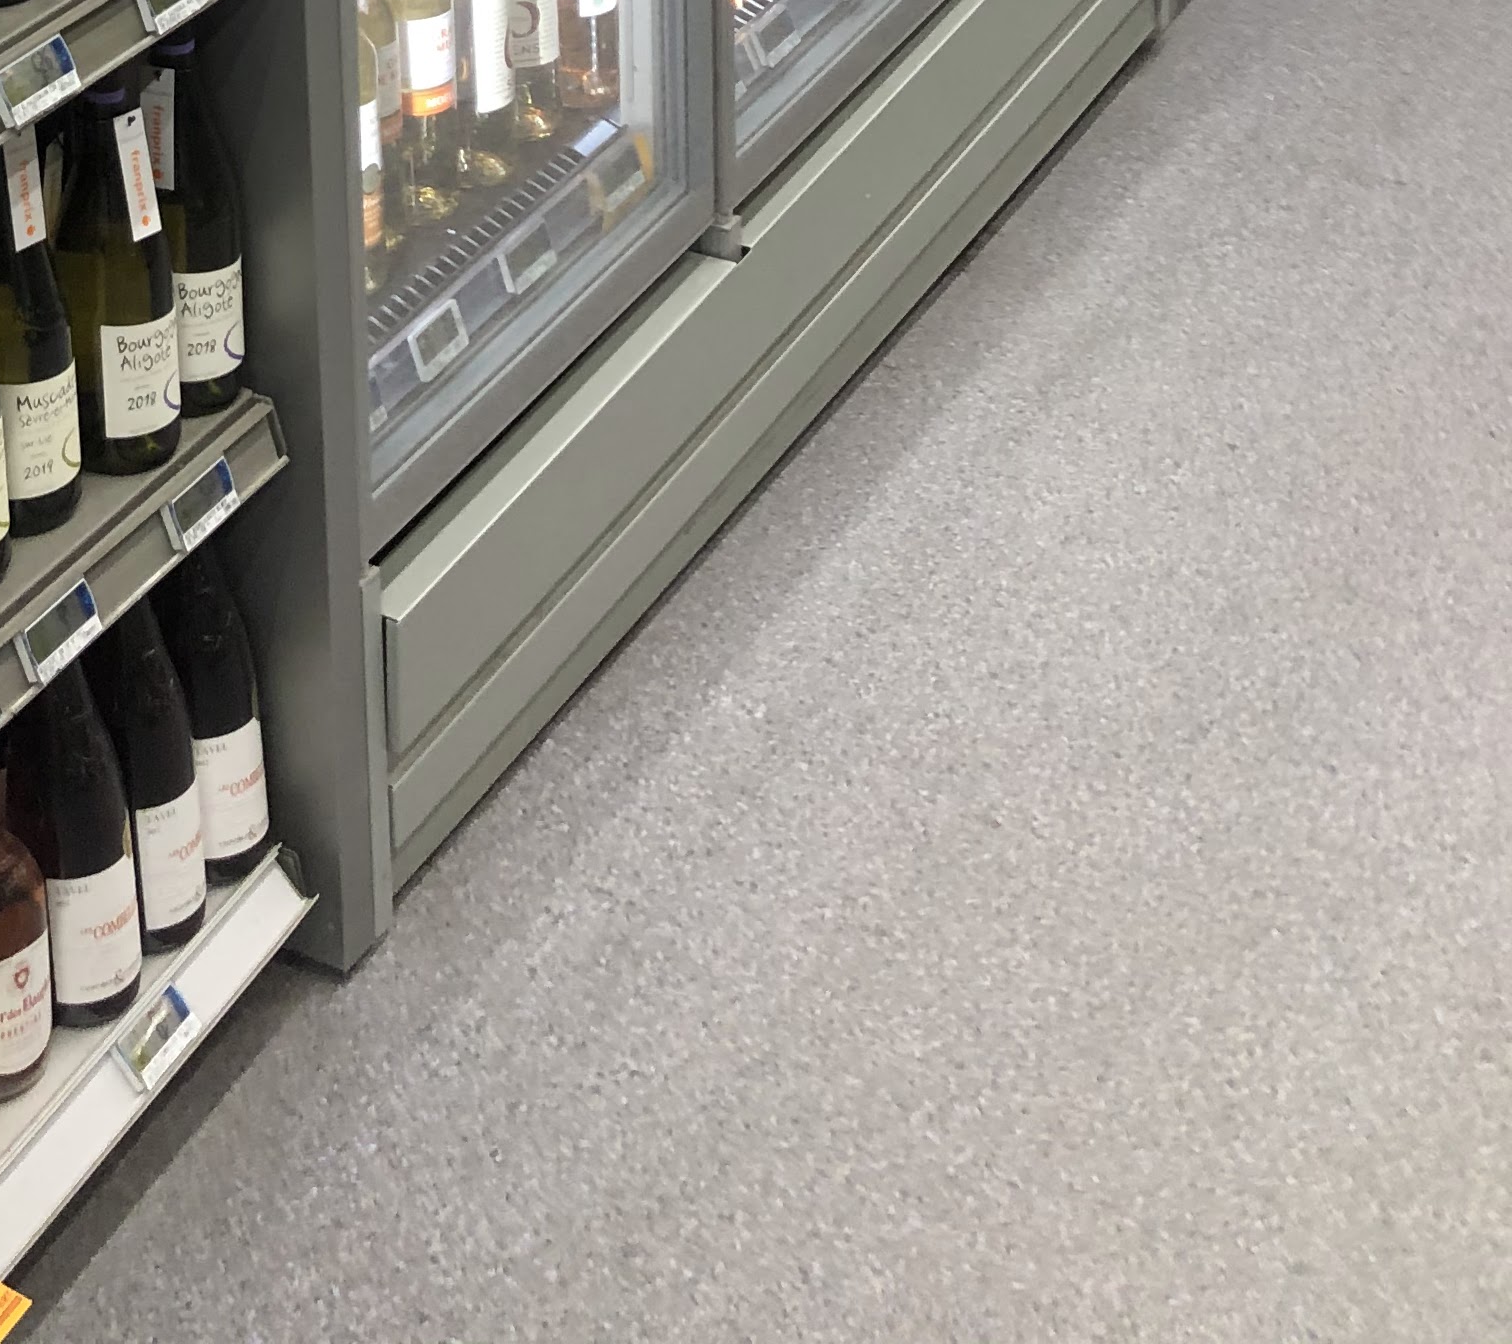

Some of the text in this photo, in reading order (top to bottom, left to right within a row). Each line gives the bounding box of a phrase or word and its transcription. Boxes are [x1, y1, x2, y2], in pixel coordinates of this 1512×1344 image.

[130, 148, 149, 214] franprix
[187, 337, 218, 358] 2018
[127, 390, 158, 412] 2018
